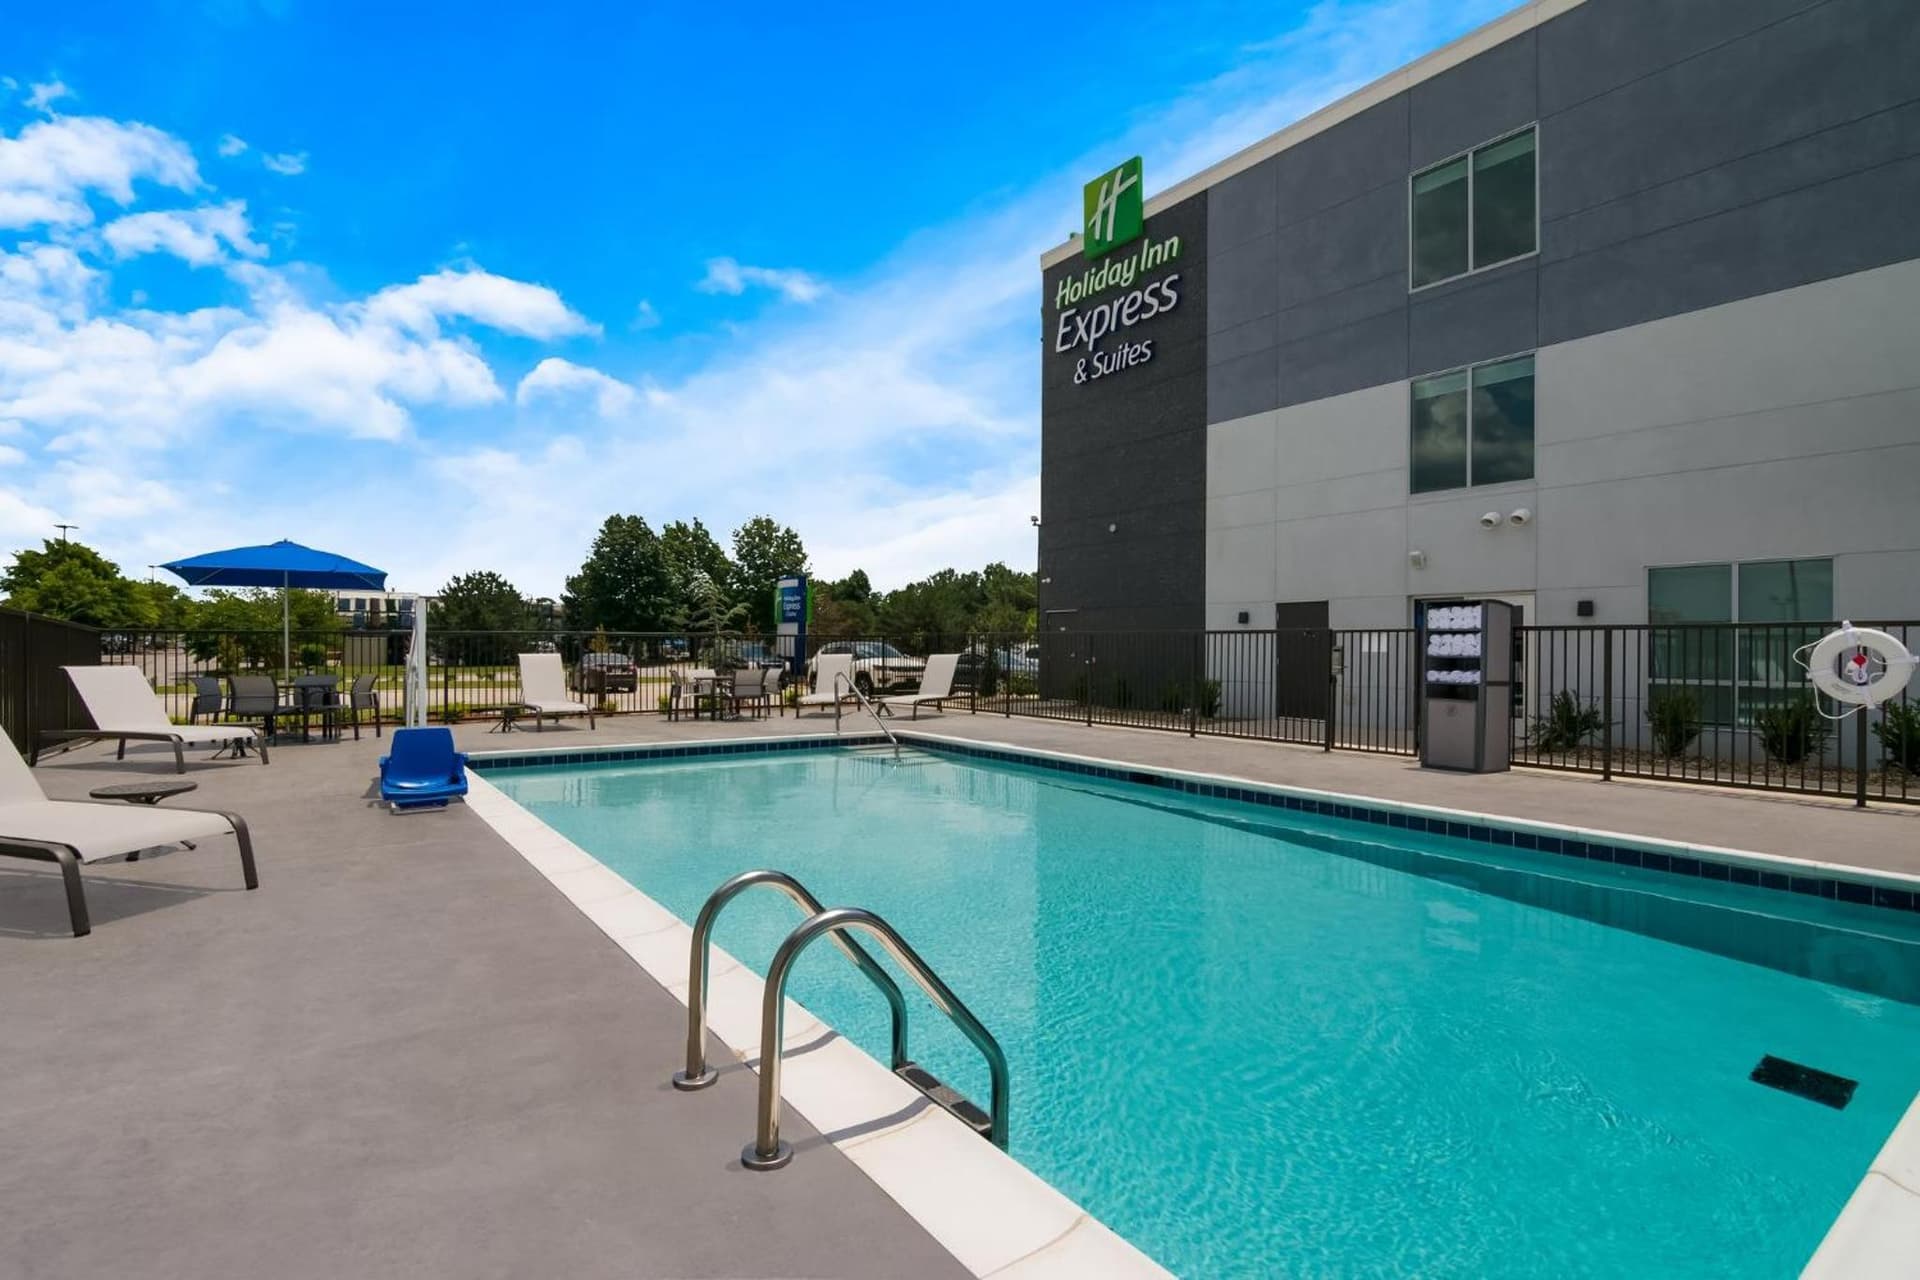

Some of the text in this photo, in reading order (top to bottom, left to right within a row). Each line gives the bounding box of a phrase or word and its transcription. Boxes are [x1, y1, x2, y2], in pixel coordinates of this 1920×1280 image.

[1055, 235, 1179, 309] Holiday Inn
[1056, 274, 1179, 353] Express
[1073, 339, 1152, 384] & Suites
